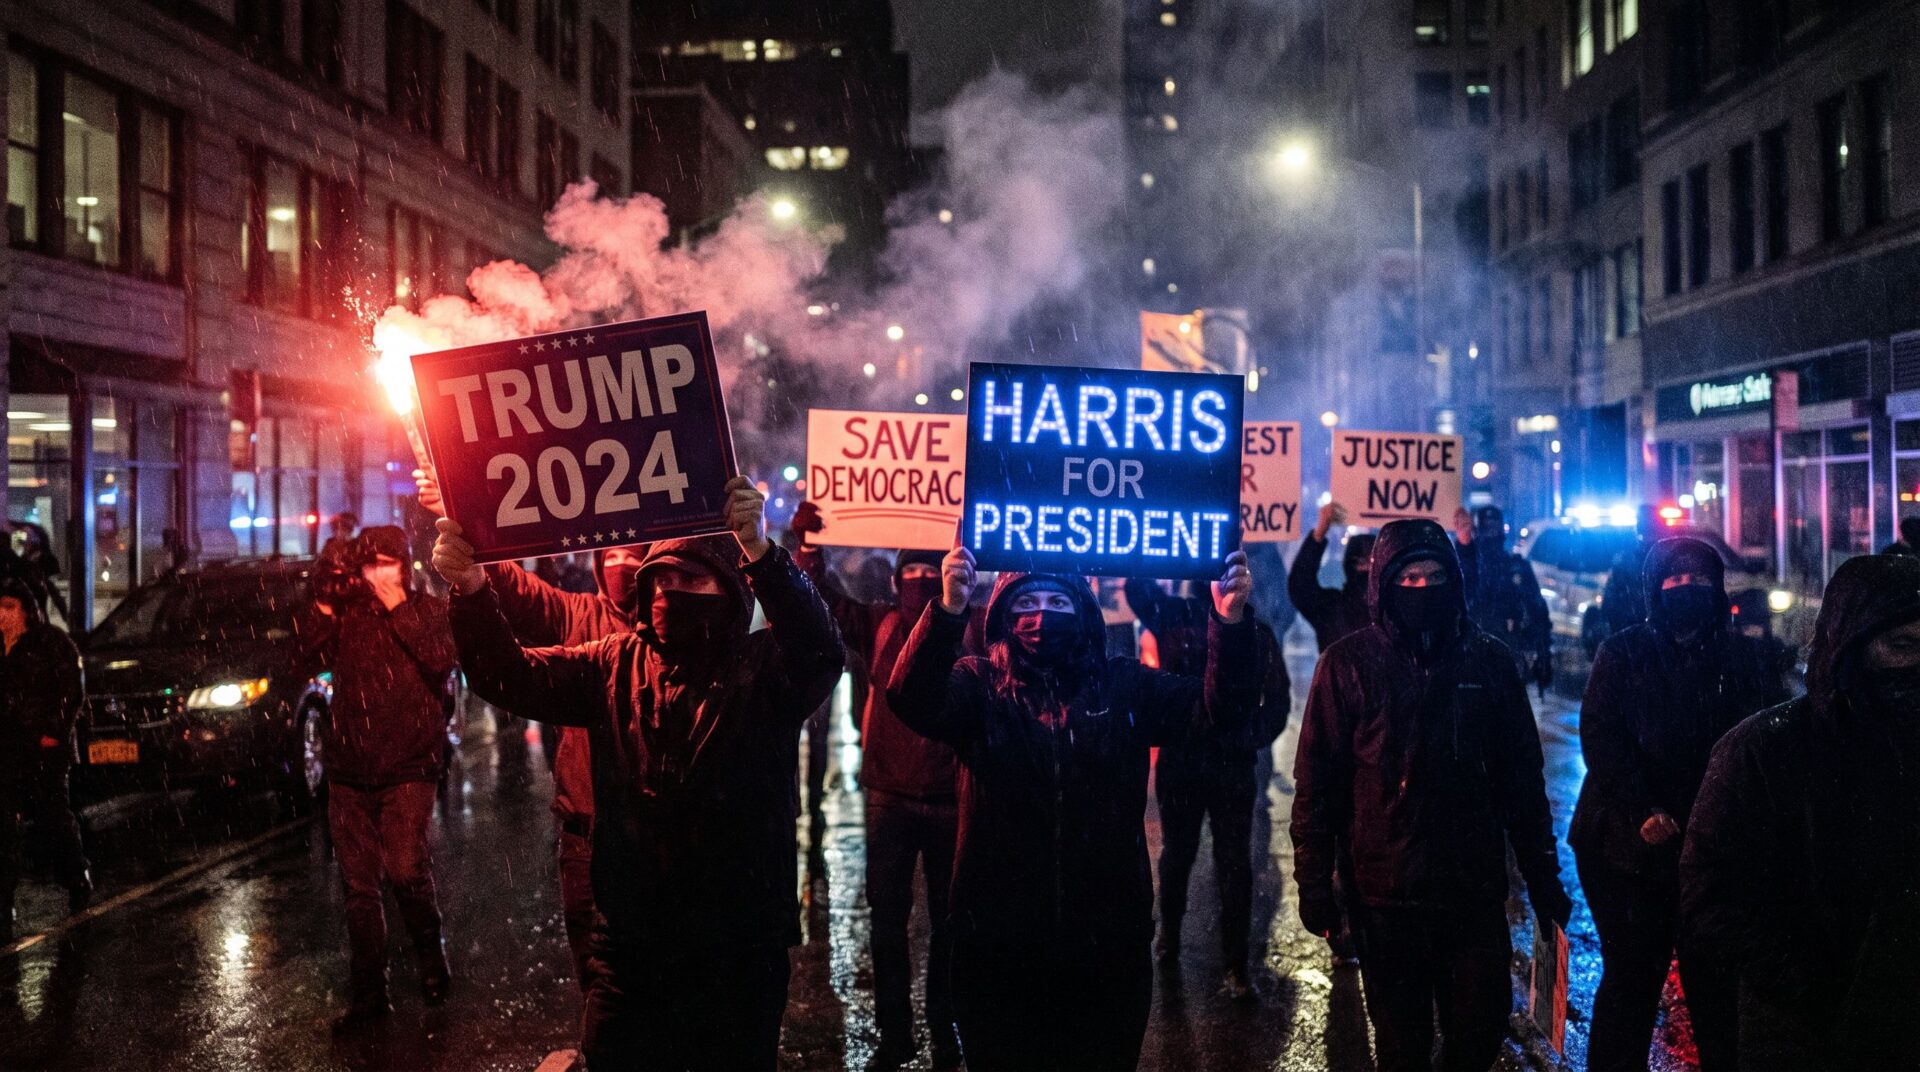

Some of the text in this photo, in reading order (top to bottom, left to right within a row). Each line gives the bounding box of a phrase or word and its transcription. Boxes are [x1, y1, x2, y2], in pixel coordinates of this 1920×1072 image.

[438, 343, 695, 443] TRUMP
[982, 380, 1227, 454] HARRIS
[842, 417, 949, 462] SAVE
[1244, 426, 1293, 456] EST
[1341, 437, 1456, 472] JUSTICE
[486, 430, 689, 528] 2024
[811, 465, 962, 506] DEMOCRAC
[1062, 457, 1144, 499] FOR
[1241, 463, 1258, 492] R
[1367, 479, 1438, 512] NOW
[973, 503, 1230, 560] PRESIDENT
[1240, 503, 1297, 532] RACY
